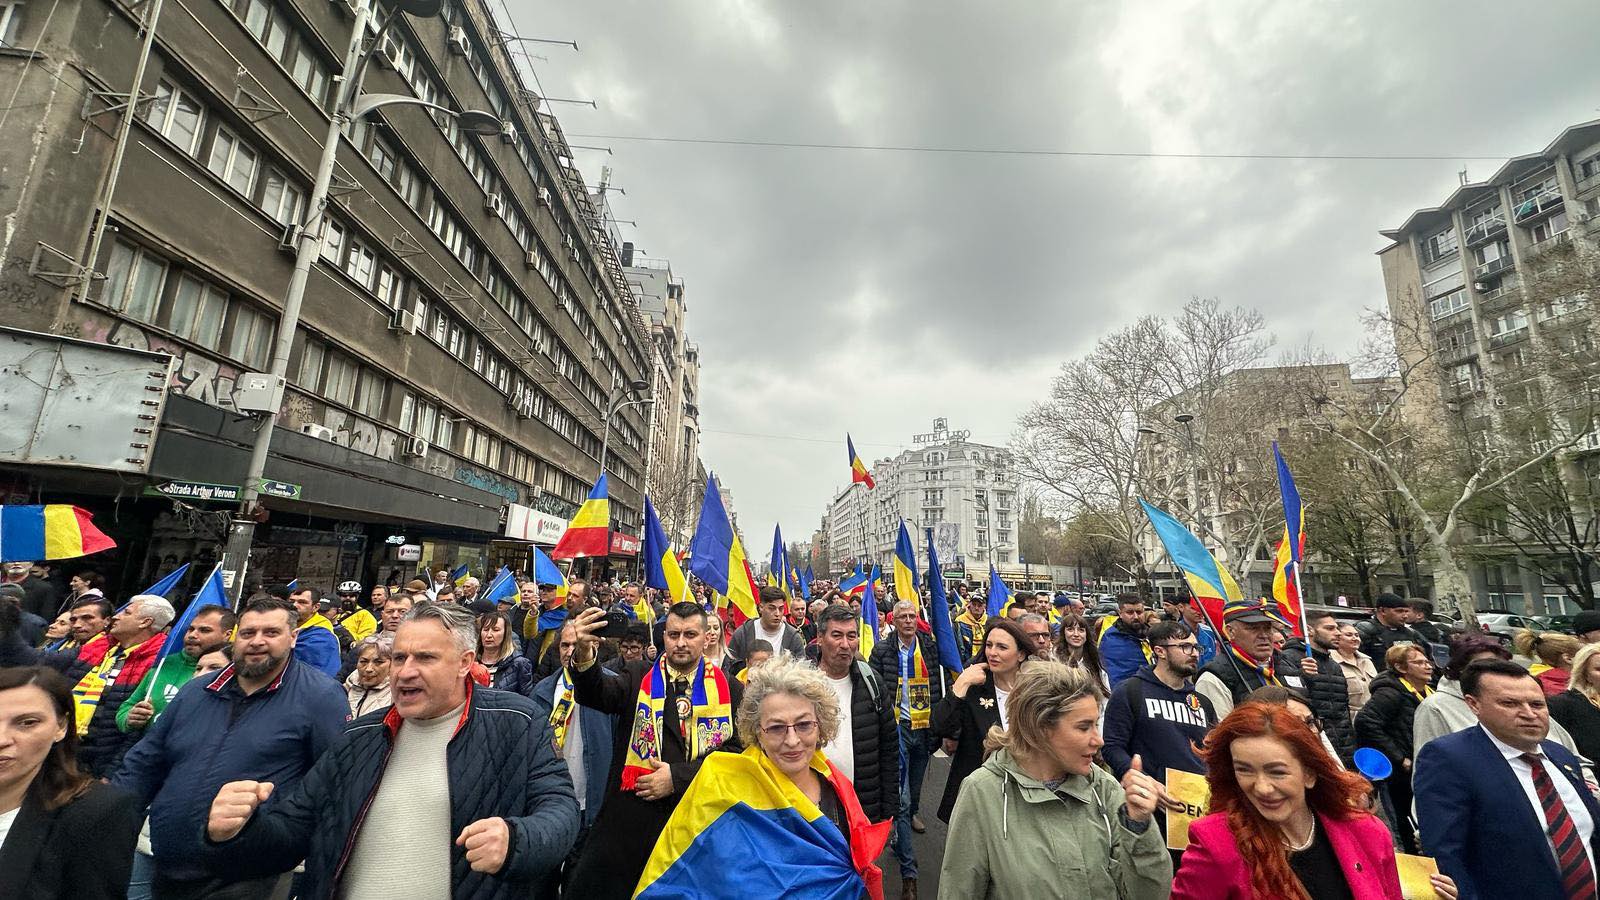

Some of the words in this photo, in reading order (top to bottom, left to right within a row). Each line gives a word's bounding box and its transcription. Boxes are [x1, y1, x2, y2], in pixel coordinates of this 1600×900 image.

[912, 432, 944, 443] HOTEL
[169, 483, 191, 495] Strada
[191, 486, 212, 497] Arthur
[214, 487, 236, 498] Verona
